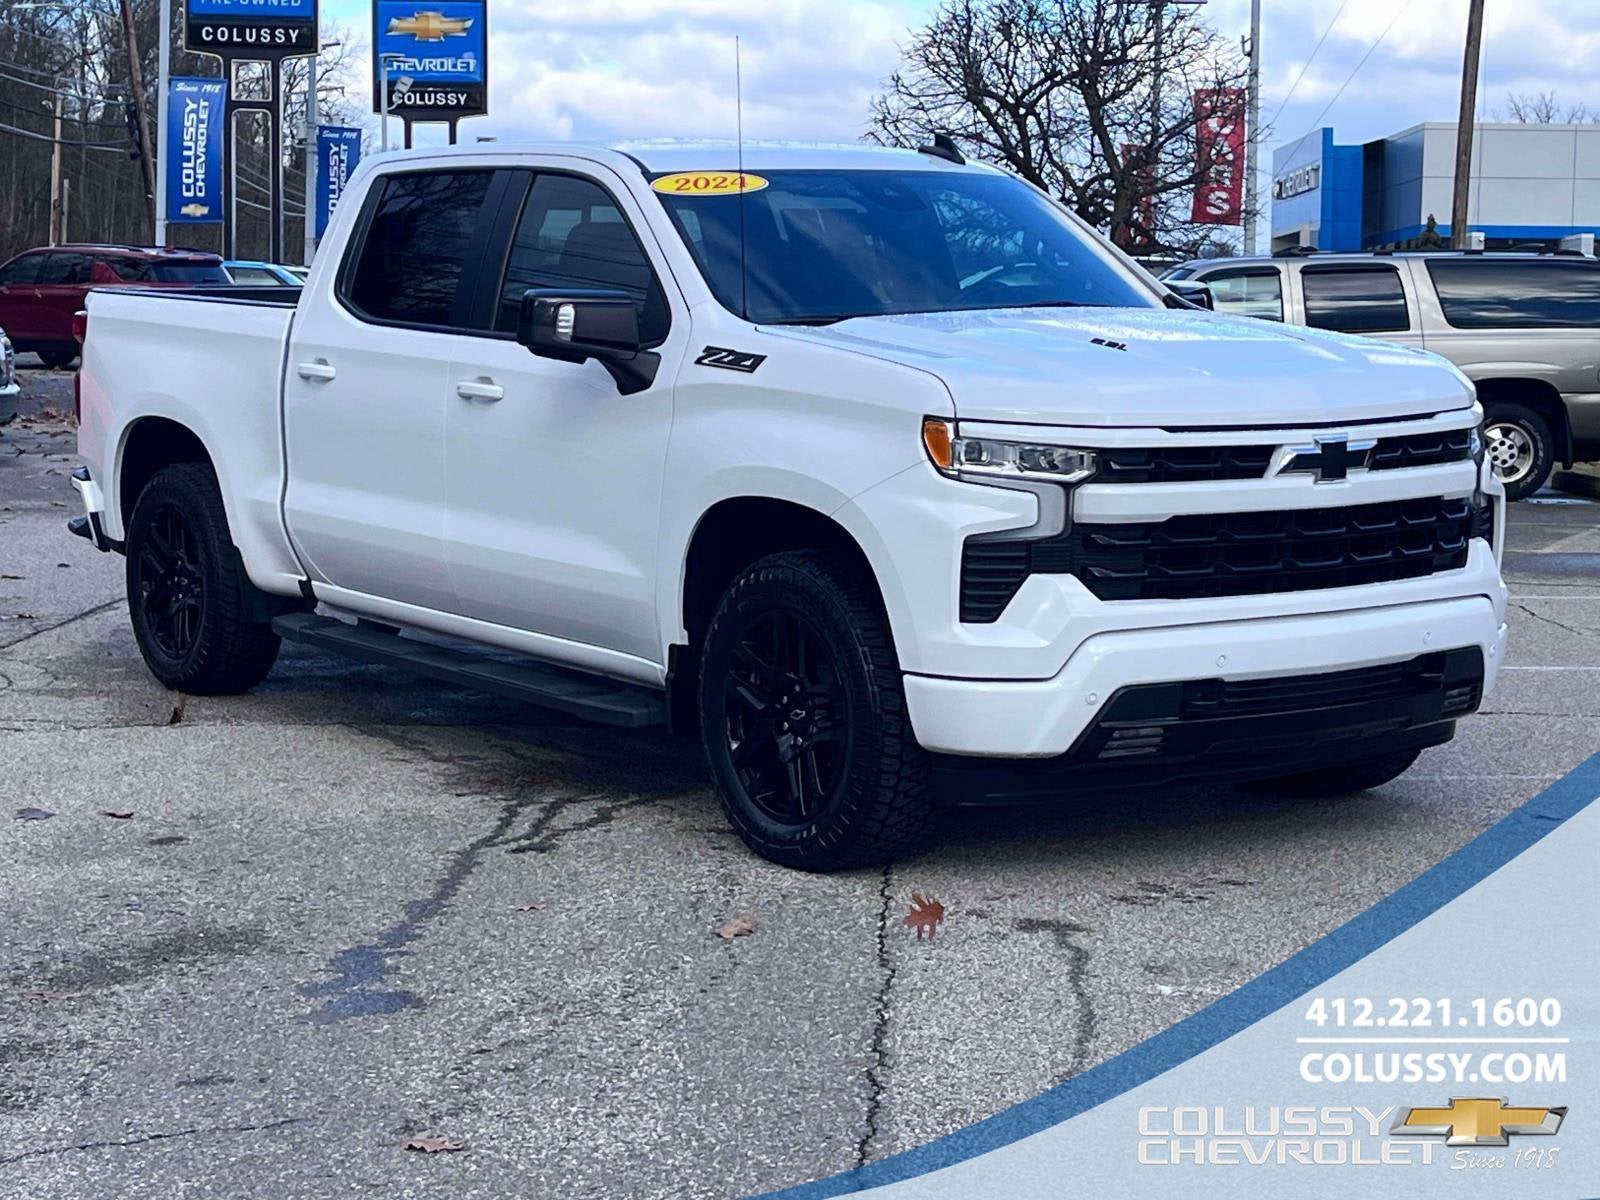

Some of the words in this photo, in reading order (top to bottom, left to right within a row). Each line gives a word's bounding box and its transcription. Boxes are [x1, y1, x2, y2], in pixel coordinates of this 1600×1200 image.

[201, 26, 299, 43] COLUSSY
[182, 97, 198, 198] COLUSSY
[196, 99, 209, 198] CHEVROLET
[674, 175, 748, 192] 2024
